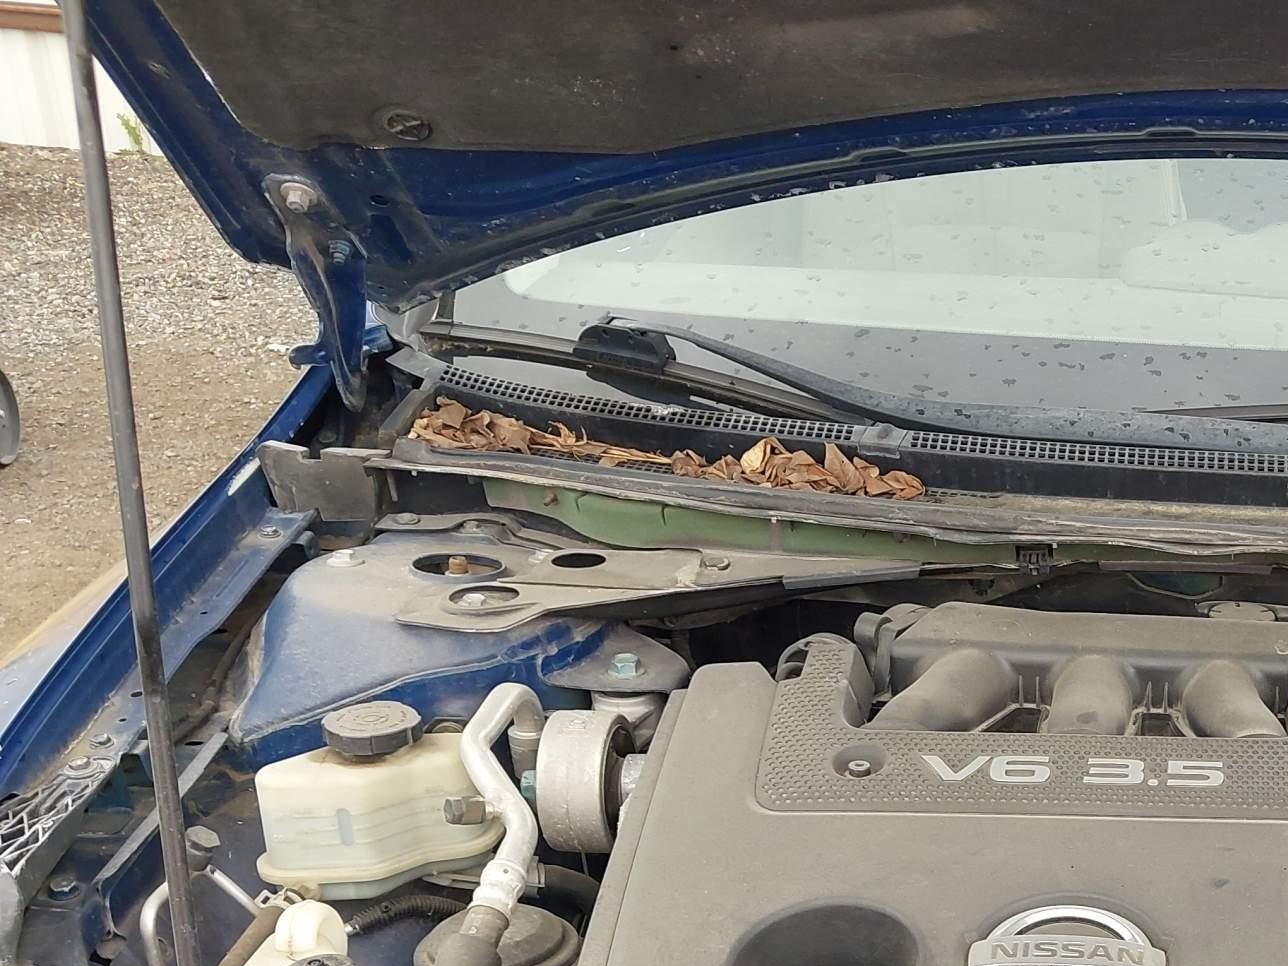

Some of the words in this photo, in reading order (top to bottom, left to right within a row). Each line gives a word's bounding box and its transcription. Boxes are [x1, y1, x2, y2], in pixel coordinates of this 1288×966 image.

[920, 754, 1051, 784] V6
[1082, 757, 1225, 787] 3.5
[990, 940, 1146, 966] NISSAN
